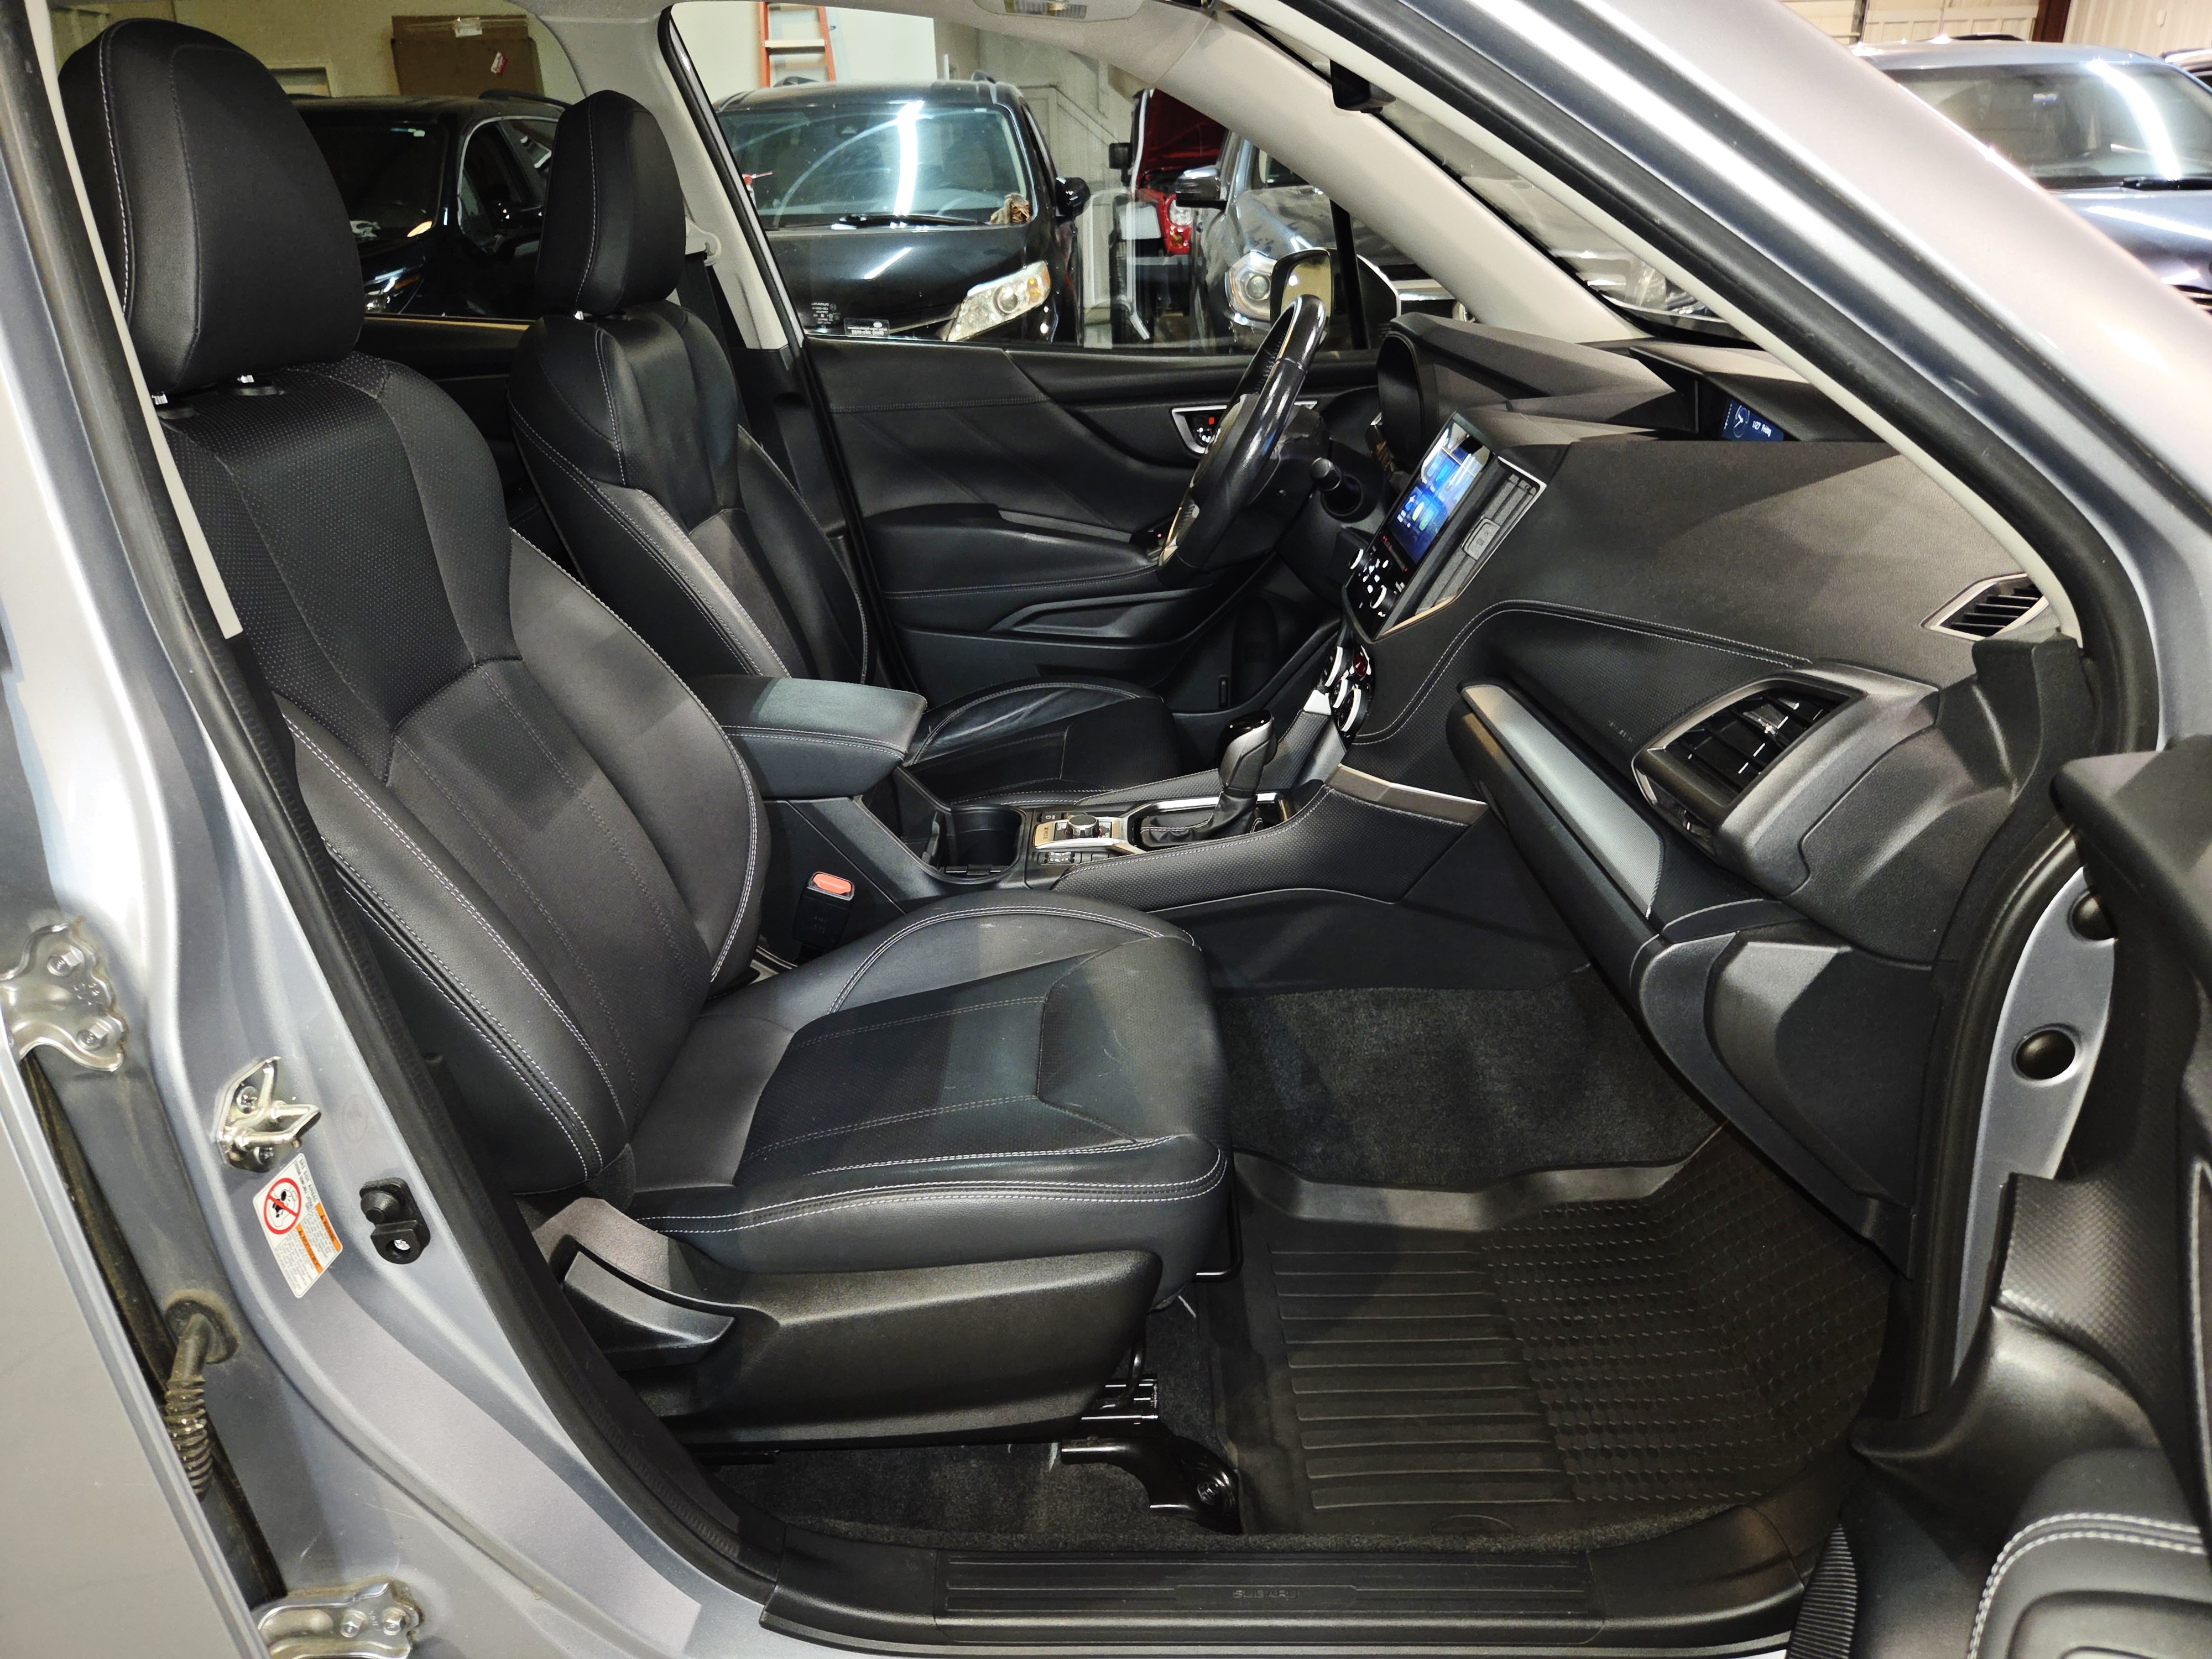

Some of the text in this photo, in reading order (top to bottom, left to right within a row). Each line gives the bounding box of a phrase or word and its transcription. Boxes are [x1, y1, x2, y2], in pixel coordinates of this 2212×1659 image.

[1752, 420, 1772, 437] 1/27 Friday
[1232, 1590, 1299, 1599] SUBARU
